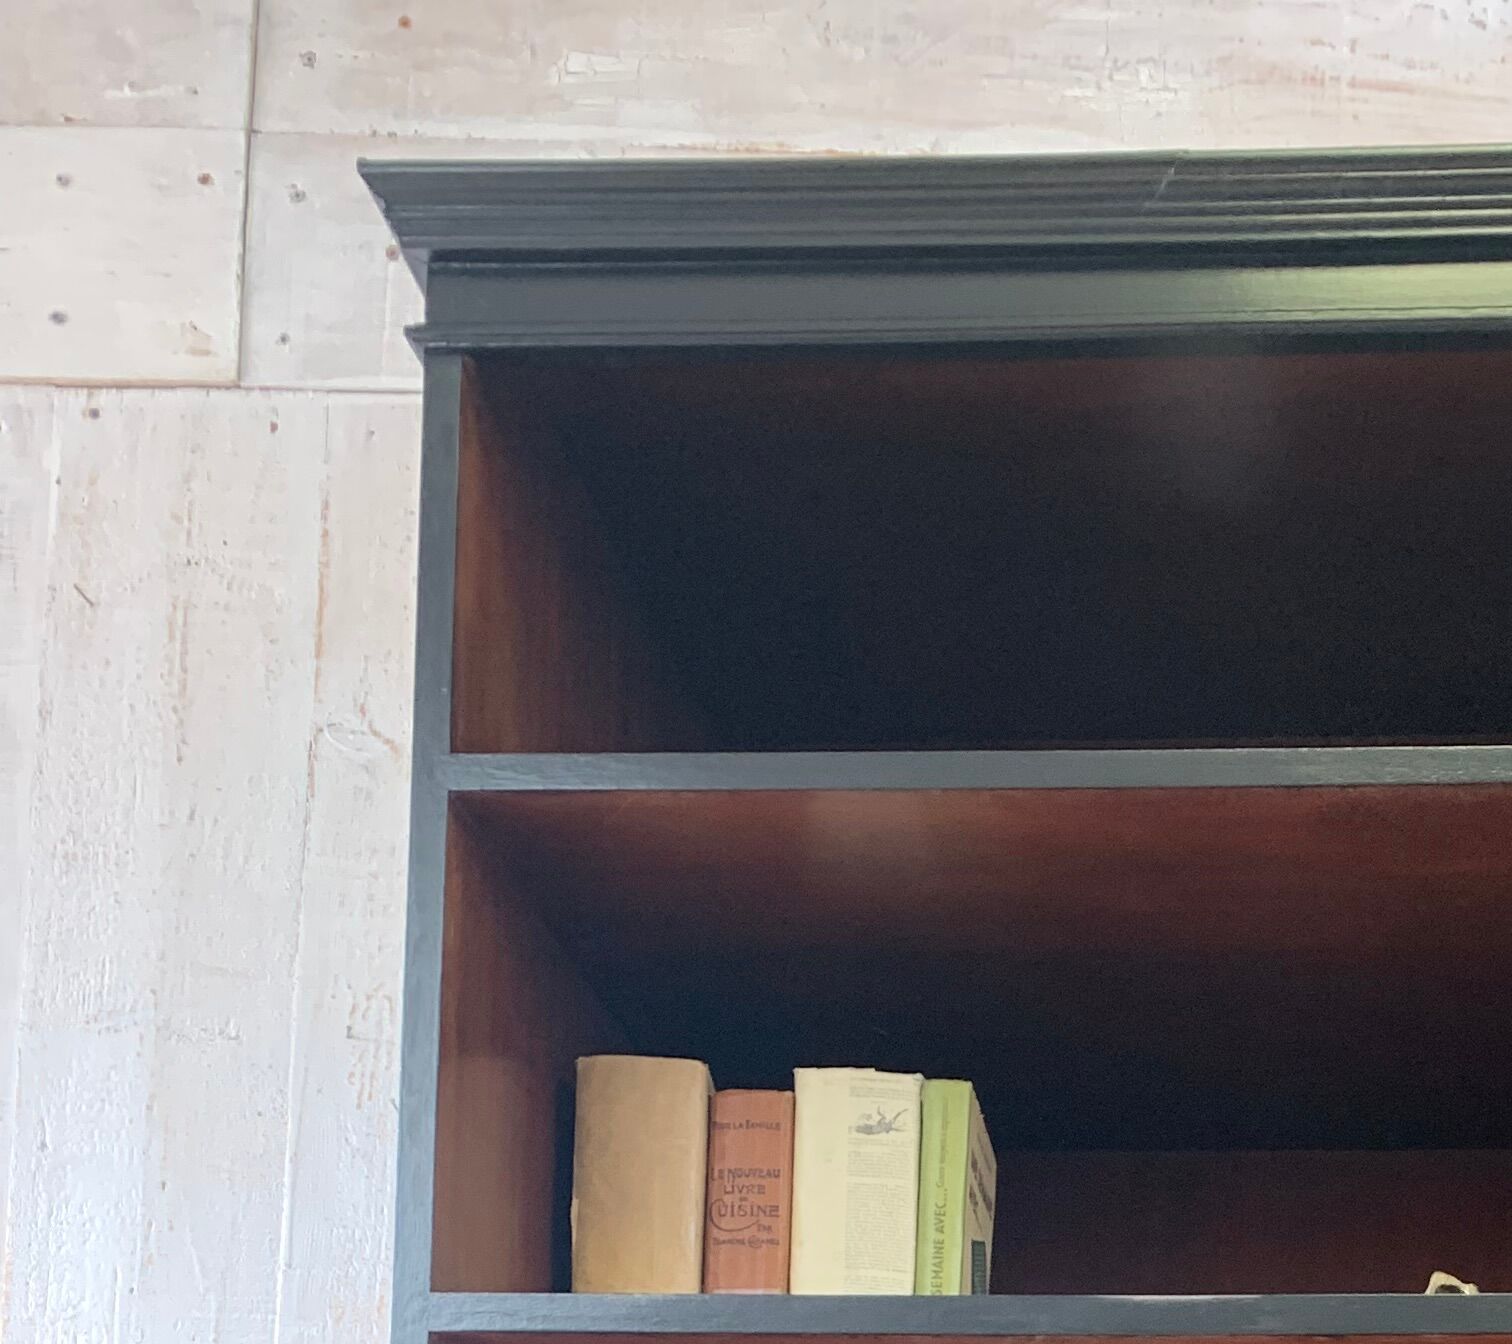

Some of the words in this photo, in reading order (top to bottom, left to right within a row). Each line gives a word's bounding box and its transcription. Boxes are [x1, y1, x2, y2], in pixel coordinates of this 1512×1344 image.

[711, 1167, 725, 1182] LE
[727, 1167, 781, 1184] NOUVEAU
[723, 1183, 766, 1195] LIVRE
[709, 1198, 780, 1232] CUISINE
